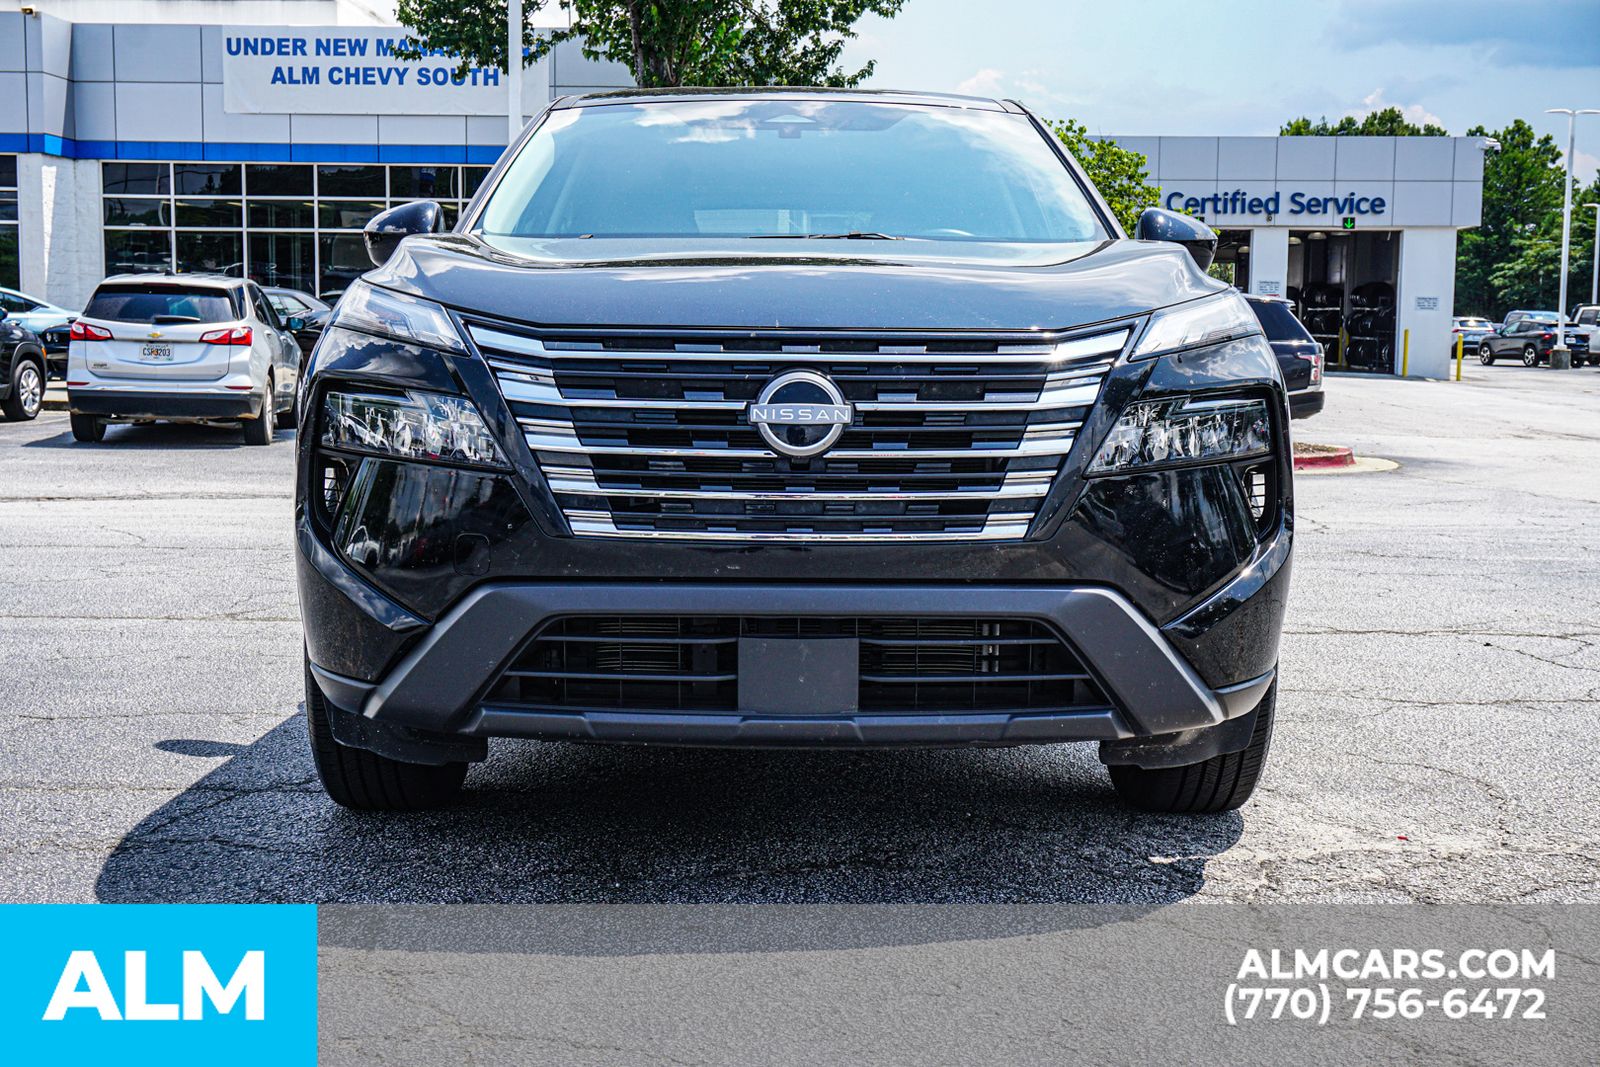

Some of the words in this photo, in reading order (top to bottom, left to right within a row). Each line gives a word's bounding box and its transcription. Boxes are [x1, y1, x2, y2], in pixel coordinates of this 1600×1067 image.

[226, 37, 307, 56] UNDER
[315, 38, 368, 56] NEW
[271, 66, 320, 85] ALM
[328, 67, 409, 86] CHEVY
[417, 67, 499, 87] SOUTH
[1166, 191, 1280, 215] Certified
[1289, 192, 1386, 215] Service
[753, 408, 849, 421] NISSAN
